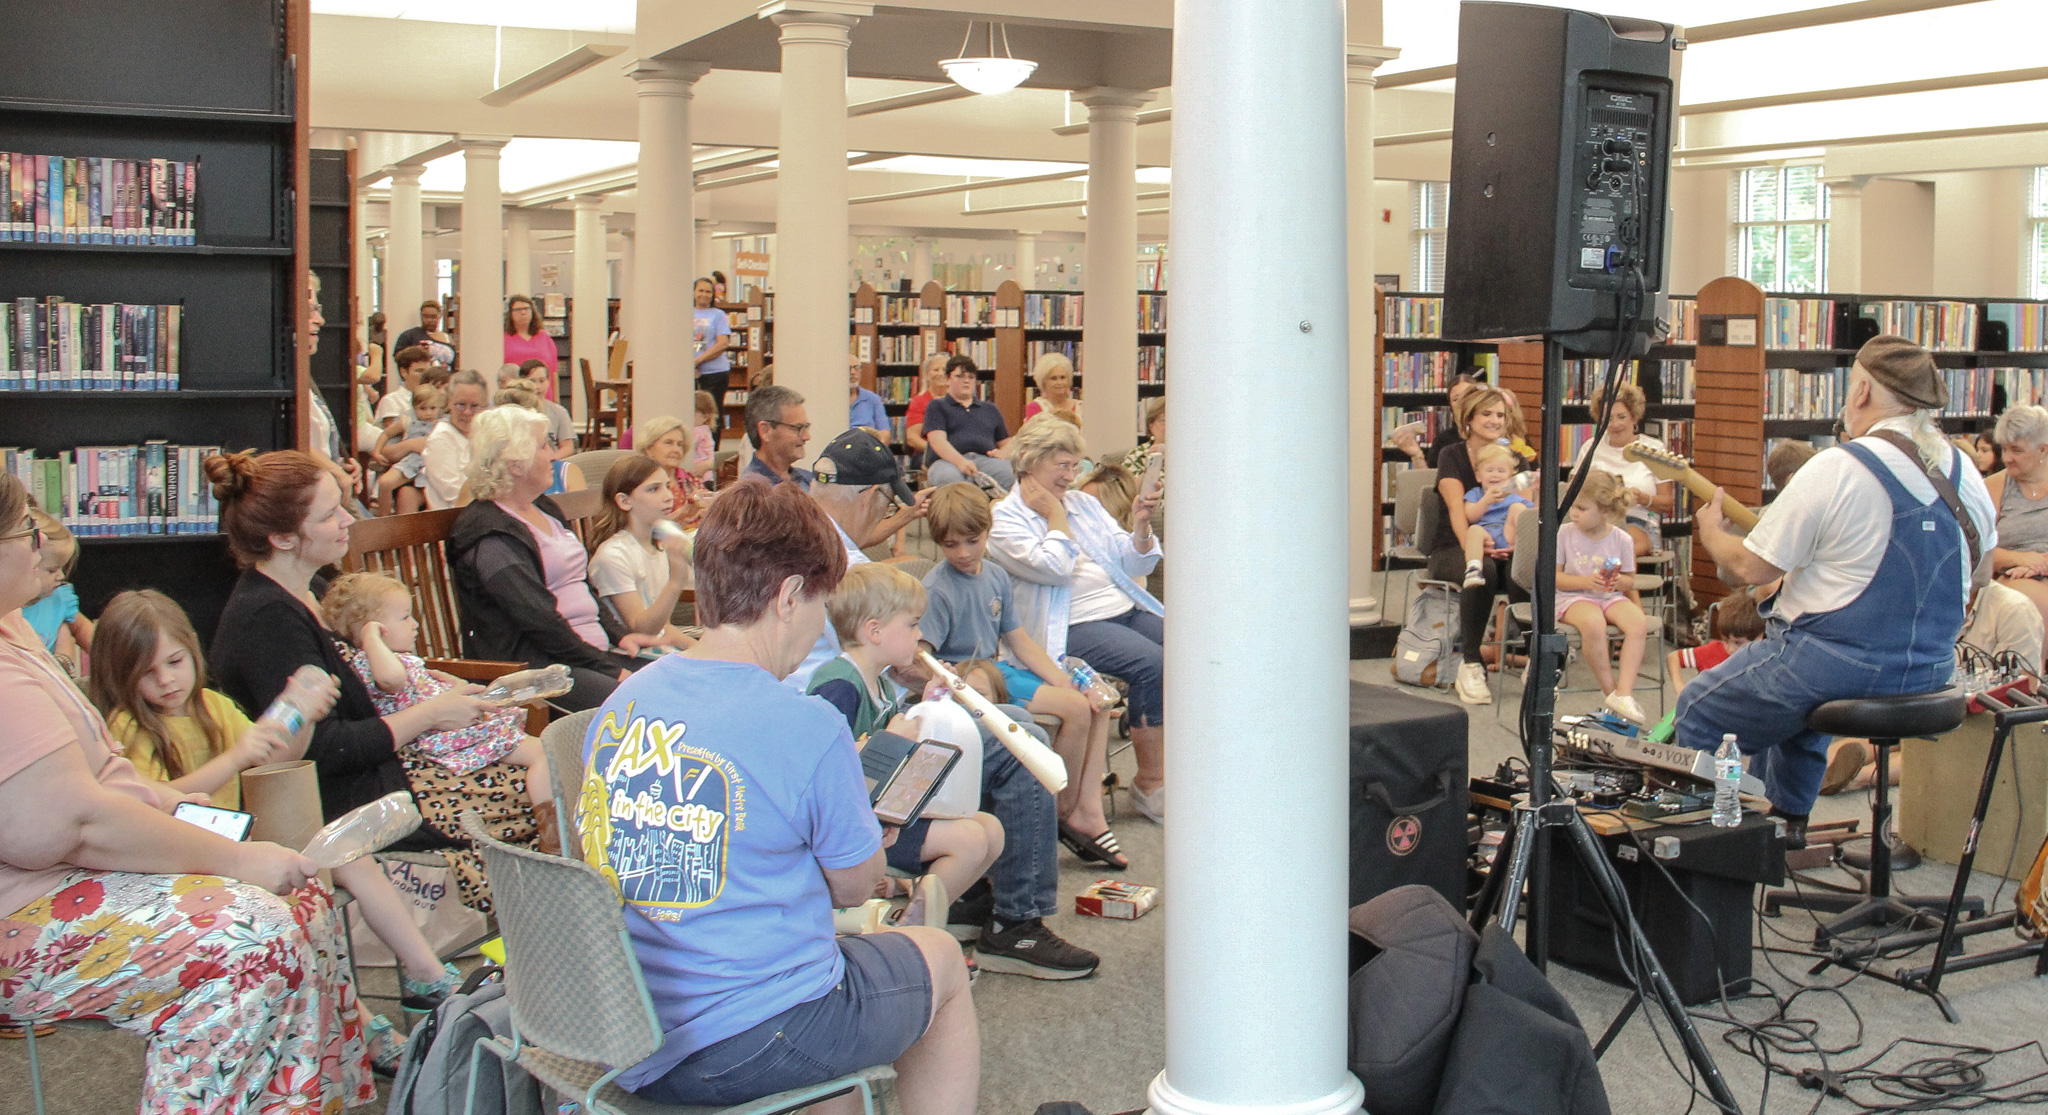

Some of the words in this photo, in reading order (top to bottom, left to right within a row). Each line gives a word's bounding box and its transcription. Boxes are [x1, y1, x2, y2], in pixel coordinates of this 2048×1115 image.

[168, 459, 177, 500] BATHSHEBA
[677, 742, 716, 761] Presented
[714, 753, 726, 766] by
[725, 761, 745, 784] First
[1665, 749, 1692, 767] VOX
[611, 788, 633, 822] in
[634, 791, 666, 829] the
[666, 802, 725, 843] city
